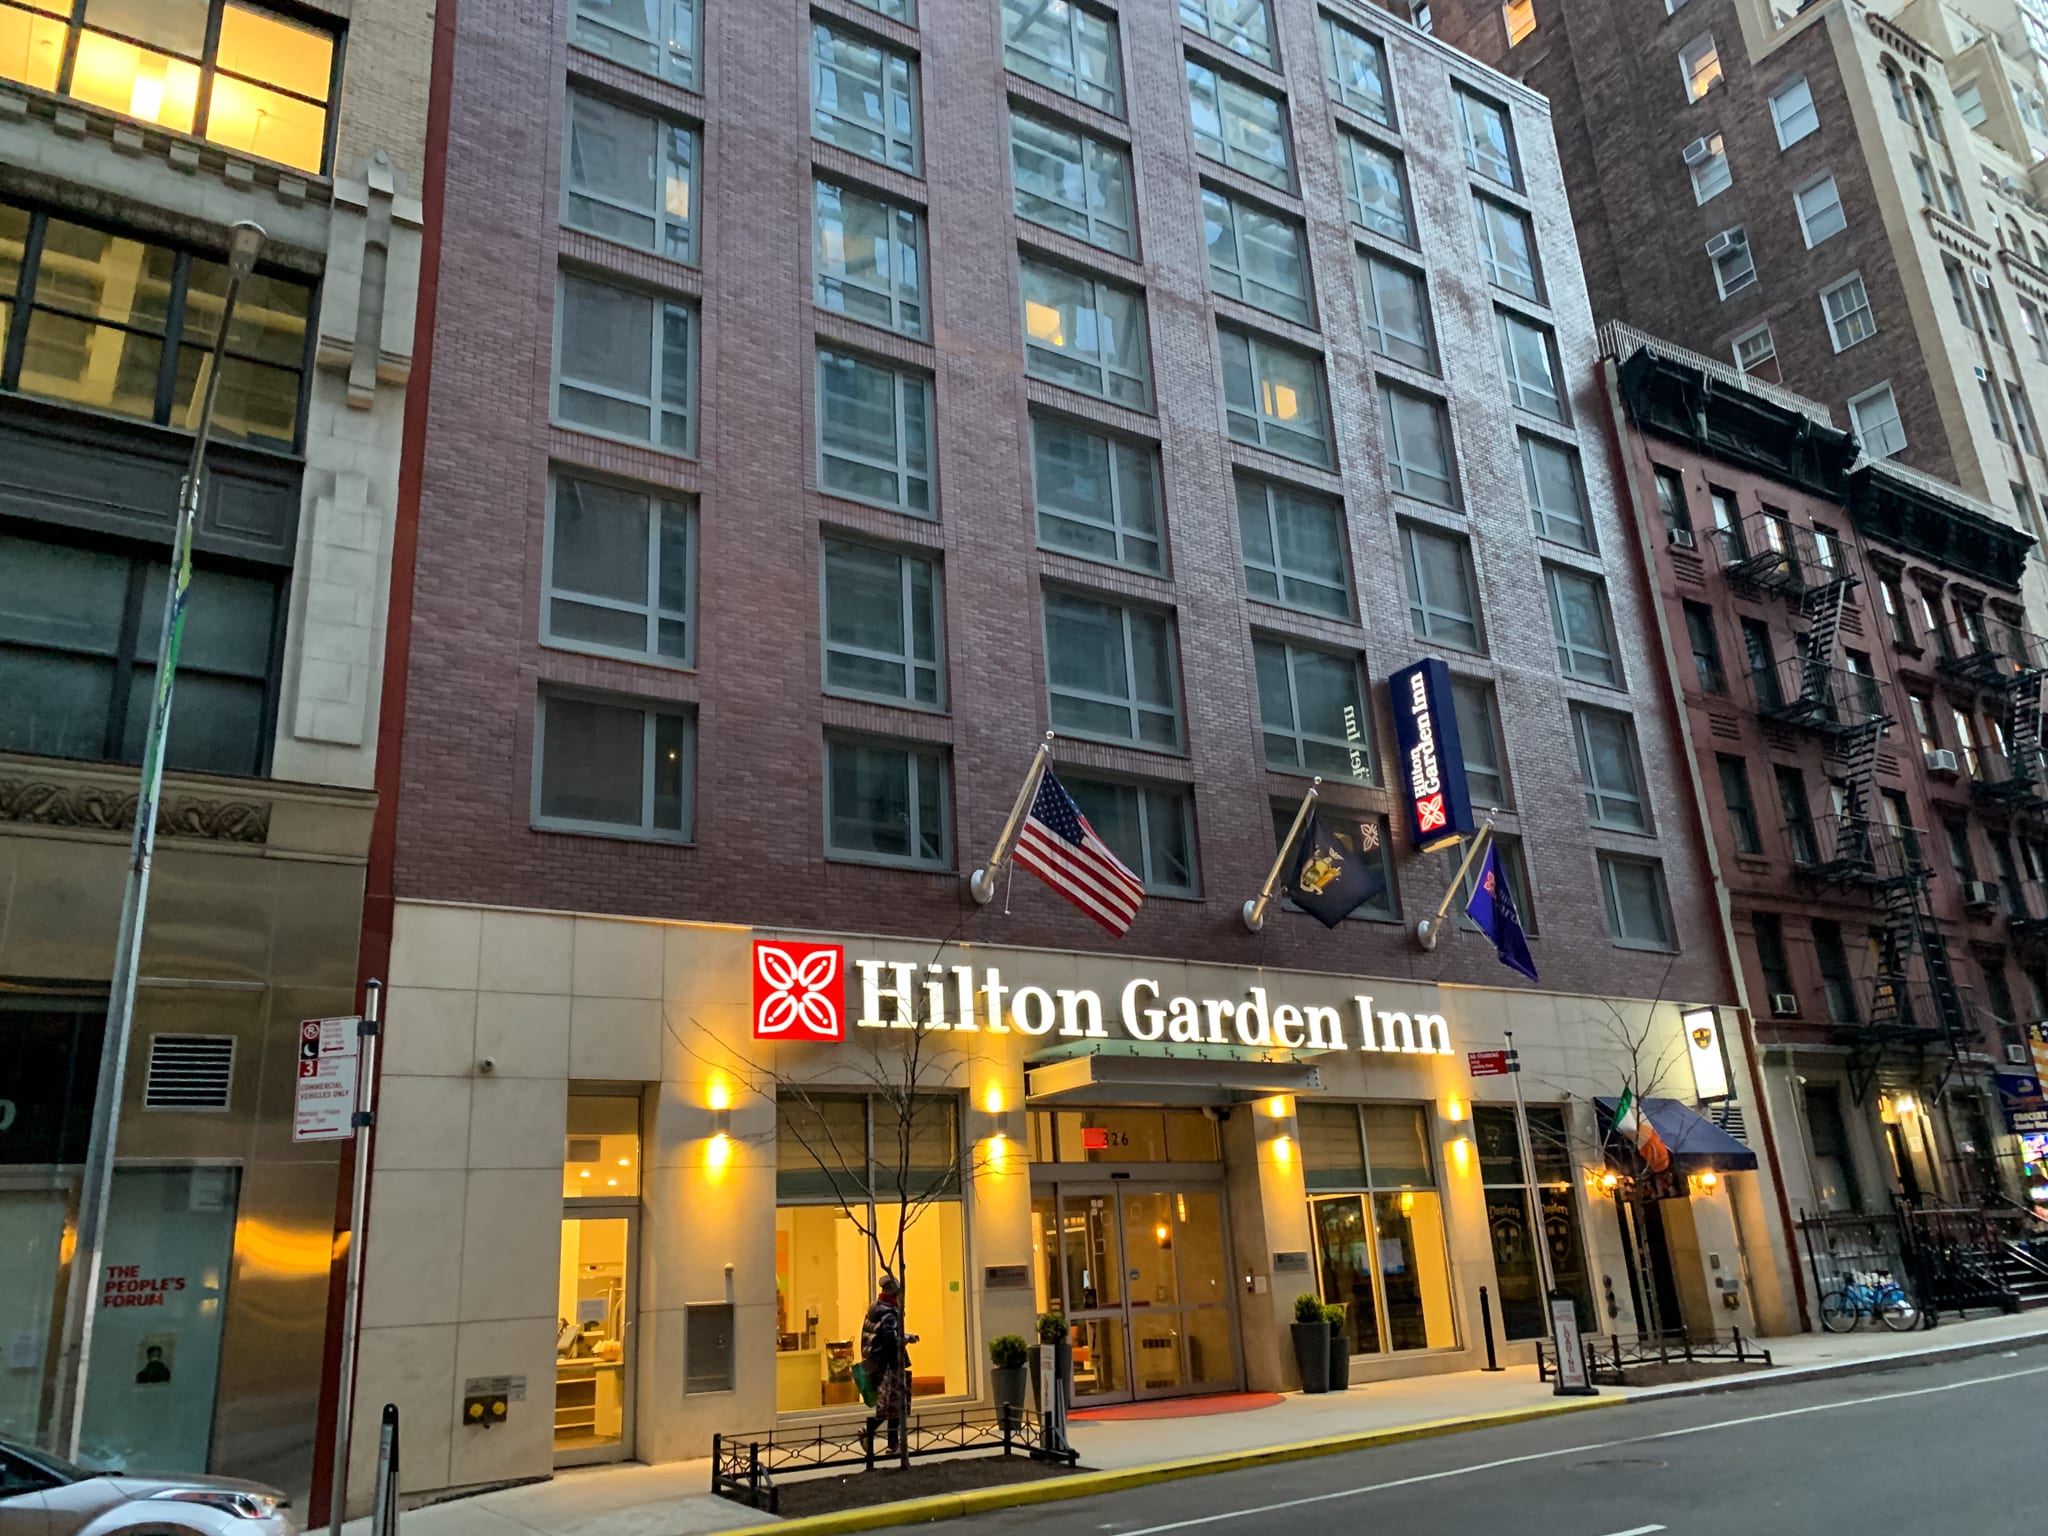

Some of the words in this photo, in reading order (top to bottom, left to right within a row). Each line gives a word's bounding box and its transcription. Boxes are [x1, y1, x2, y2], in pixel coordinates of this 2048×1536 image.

[1409, 671, 1429, 714] Inn
[1417, 711, 1441, 796] Garden
[1409, 746, 1427, 800] Hilton
[855, 959, 1109, 1038] Hilton
[1121, 978, 1348, 1050] Garden
[1353, 995, 1455, 1055] Inn
[303, 1060, 314, 1077] 3
[300, 1082, 344, 1091] COMMERCIAL
[300, 1091, 332, 1100] VEHICLES
[333, 1089, 349, 1098] ONLY
[2013, 1111, 2047, 1122] GROCERY
[1102, 1132, 1129, 1146] 326
[107, 1265, 140, 1279] THE
[104, 1277, 187, 1293] PEOPLE'S
[102, 1293, 164, 1309] FORUM
